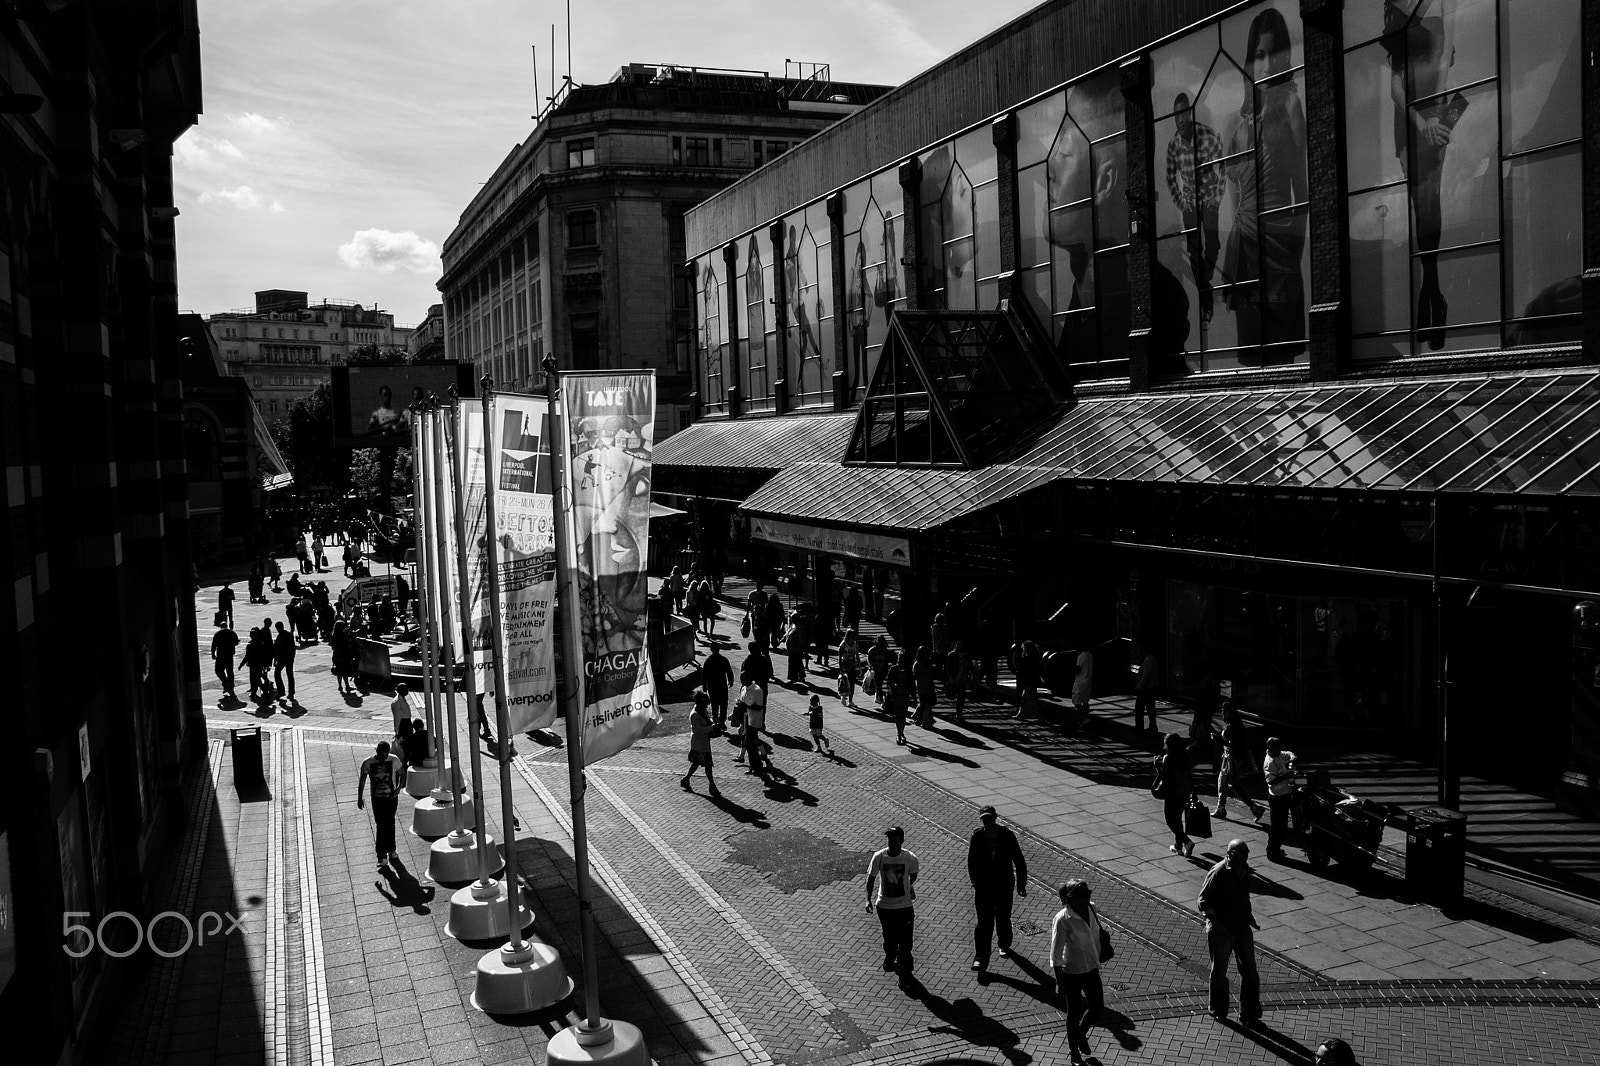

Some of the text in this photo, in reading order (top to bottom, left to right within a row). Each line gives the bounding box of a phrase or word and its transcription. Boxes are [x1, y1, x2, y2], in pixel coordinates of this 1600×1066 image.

[586, 390, 623, 407] TATE
[502, 461, 525, 469] LIVERPOOL
[537, 499, 546, 509] 26
[503, 531, 548, 552] PARK
[500, 602, 517, 611] DAYS
[519, 601, 529, 610] OF
[505, 630, 533, 641] FOR ALL
[604, 671, 634, 682] October
